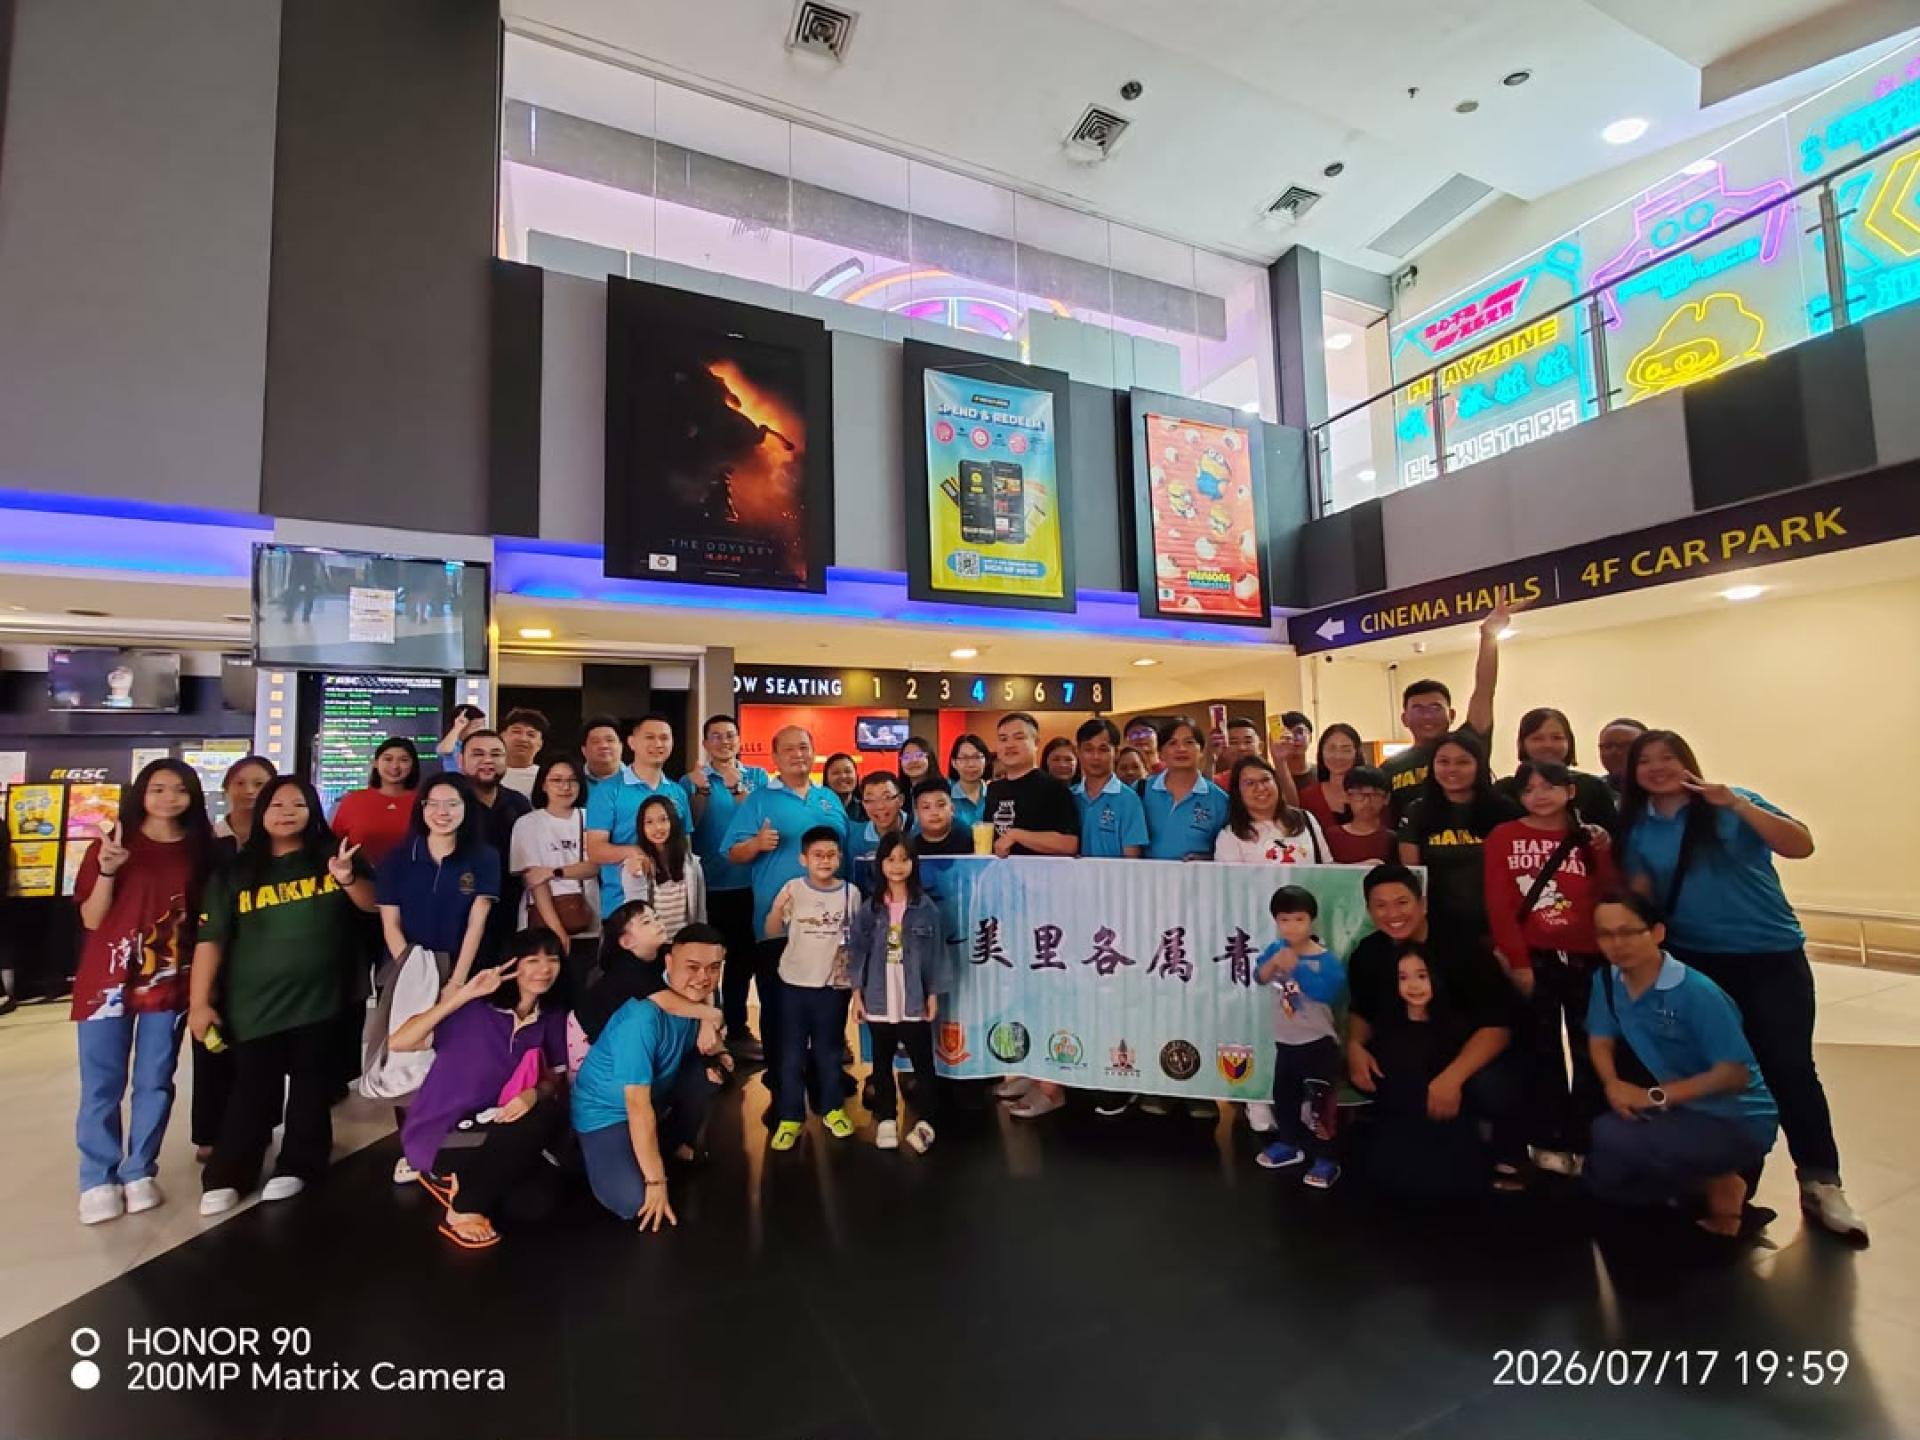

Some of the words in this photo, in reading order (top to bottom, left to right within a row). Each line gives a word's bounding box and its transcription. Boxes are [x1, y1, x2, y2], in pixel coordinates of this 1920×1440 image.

[671, 539, 698, 549] THE
[1581, 558, 1620, 588] 4F
[1630, 539, 1710, 577] CAR
[1720, 506, 1848, 559] PARK
[1361, 599, 1449, 634] CINEMA
[1455, 575, 1541, 614] HALLS
[733, 675, 758, 693] OW
[765, 676, 843, 696] SEATING
[872, 677, 881, 698] 1
[906, 678, 918, 700] 2
[939, 679, 951, 700] 3
[971, 680, 985, 703] 4
[1004, 681, 1014, 701] 5
[1034, 682, 1045, 703] 6
[1062, 682, 1075, 704] 7
[1092, 683, 1103, 703] 8
[66, 767, 110, 780] GSC
